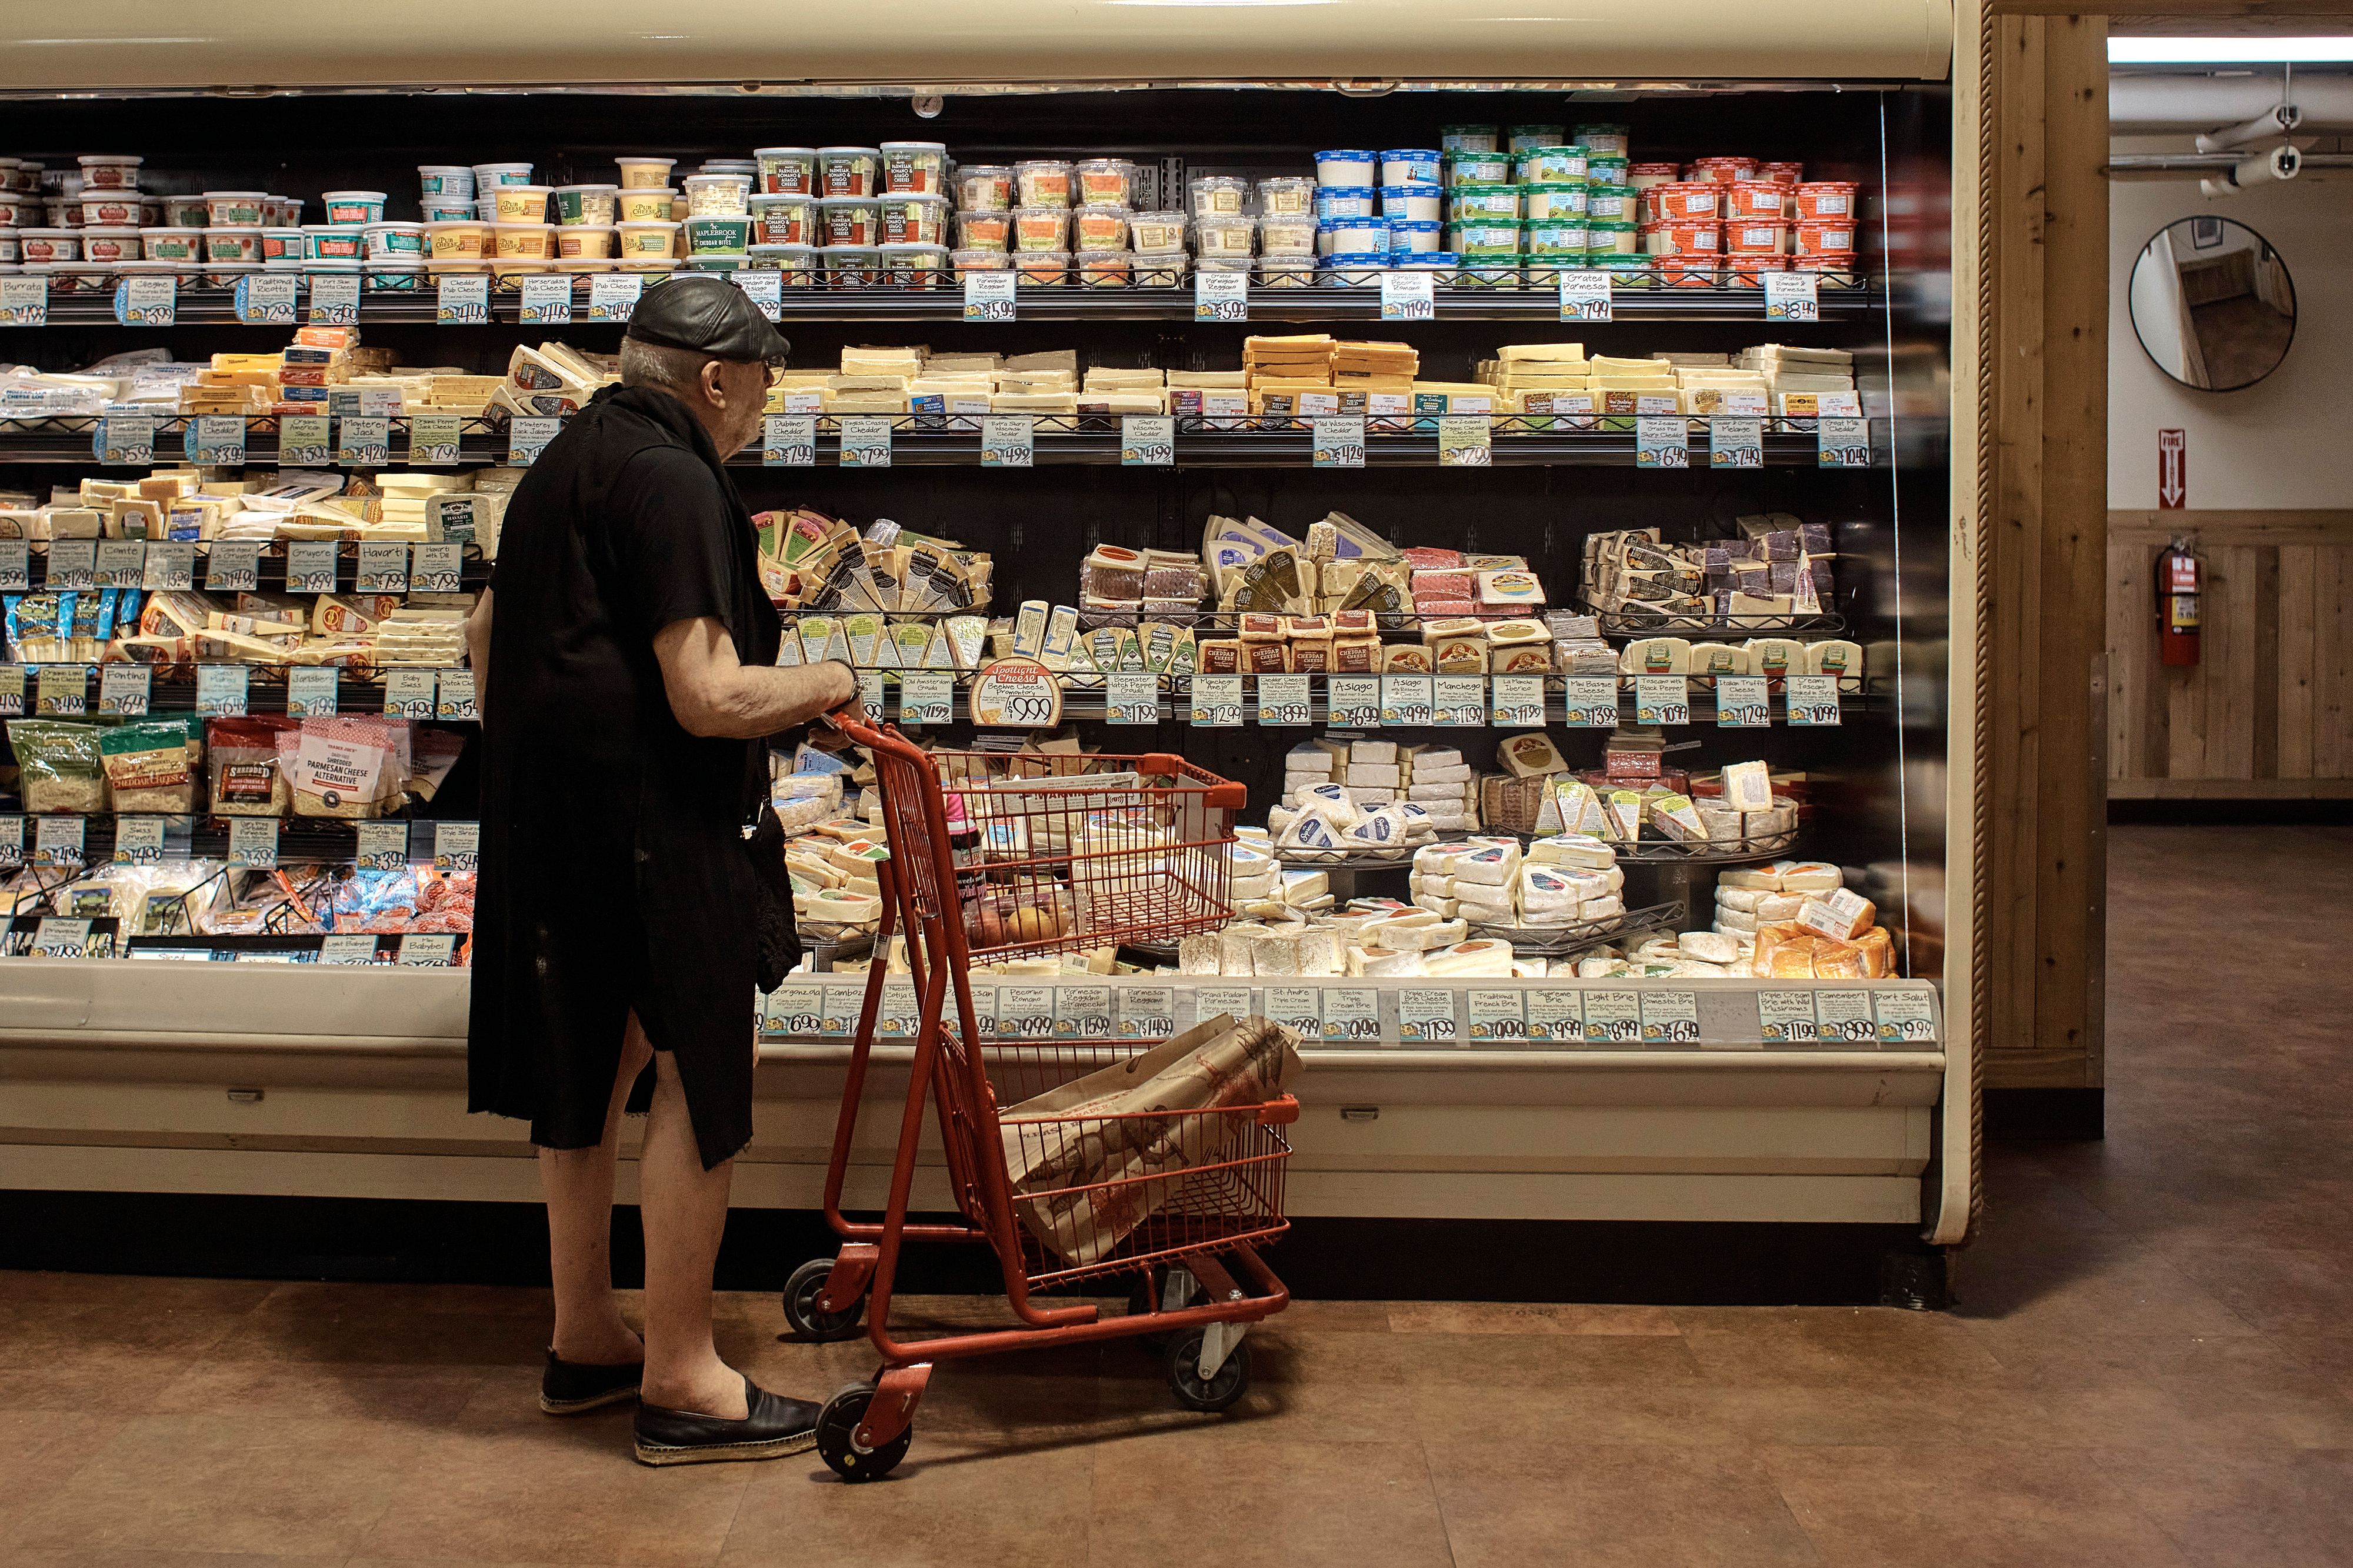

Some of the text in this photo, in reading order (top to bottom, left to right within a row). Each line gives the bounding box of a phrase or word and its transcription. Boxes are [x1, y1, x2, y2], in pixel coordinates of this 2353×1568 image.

[696, 229, 736, 238] MAPLEBROOK
[1567, 274, 1603, 282] Grated
[4, 282, 42, 291] Burrata
[344, 420, 386, 431] Monterey
[2163, 436, 2180, 446] FIRE
[292, 549, 331, 558] Gruyere
[363, 548, 404, 558] Havarti
[919, 554, 938, 564] Amsterdam
[1252, 649, 1279, 658] CHEDDAR
[992, 665, 1039, 675] Spotlight
[106, 672, 145, 680] Fontina
[402, 674, 420, 683] Baby
[997, 673, 1037, 683] Cheese
[988, 683, 1045, 691] Beehive Cheese
[1129, 681, 1156, 689] Pepper
[1200, 678, 1234, 687] Manchego
[1393, 679, 1422, 688] Asiago
[1437, 682, 1481, 691] Manchego
[1335, 683, 1373, 693] Asiago
[327, 756, 352, 767] SHREDDED
[229, 765, 270, 778] SHREDDED
[307, 760, 369, 778] PARMESAN CHEESE
[112, 775, 180, 788] CHEDDAR CHEESE
[314, 770, 358, 785] ALTERNATIVE
[1300, 821, 1315, 842] Supreme
[1376, 818, 1387, 837] Supreme
[409, 942, 444, 951] Babybel
[885, 992, 907, 1000] Cotija
[1342, 995, 1361, 1003] Triple
[1535, 990, 1572, 999] Supreme
[1587, 992, 1635, 1002] Light Brie
[1875, 993, 1929, 1002] Port Salut
[1129, 996, 1164, 1005] Reggiano
